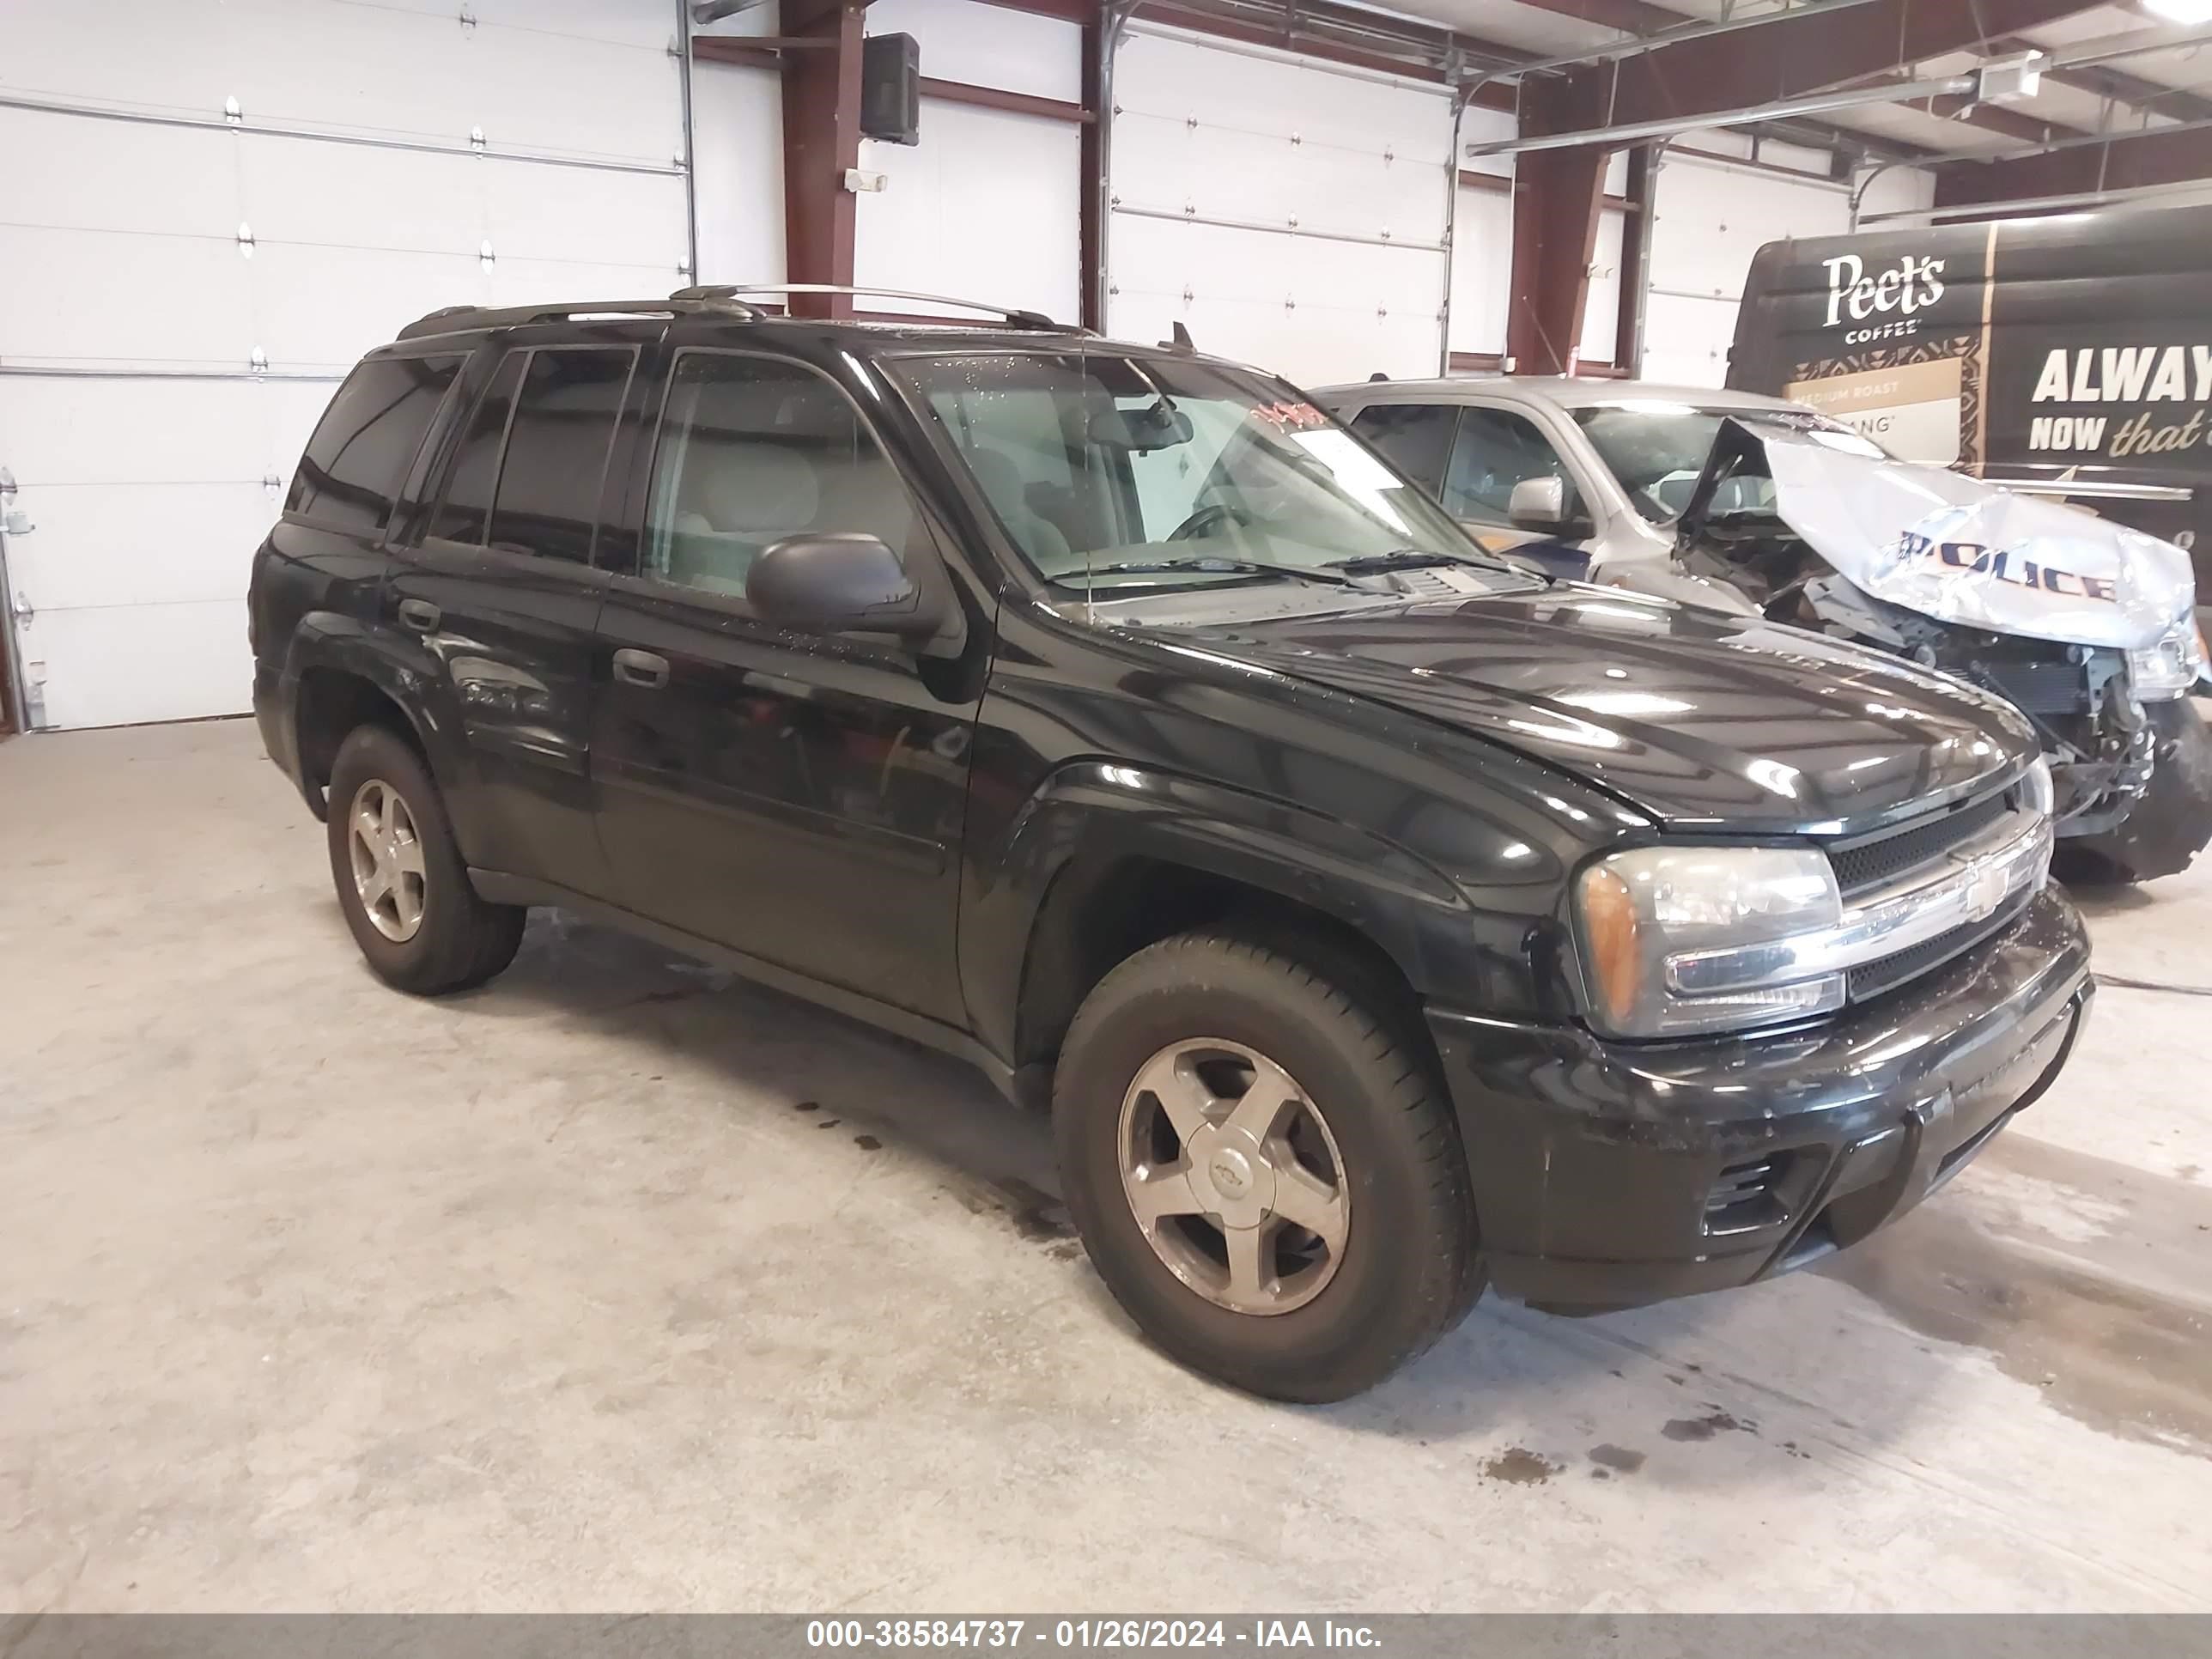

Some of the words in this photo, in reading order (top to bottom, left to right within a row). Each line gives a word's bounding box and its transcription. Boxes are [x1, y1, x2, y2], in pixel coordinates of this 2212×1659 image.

[1822, 254, 1946, 327] Peet's
[1845, 319, 1917, 345] COFFEE
[1853, 380, 1900, 399] ROAST
[2029, 417, 2108, 451] NOW
[2109, 409, 2205, 458] that
[1899, 531, 2118, 603] POLICE
